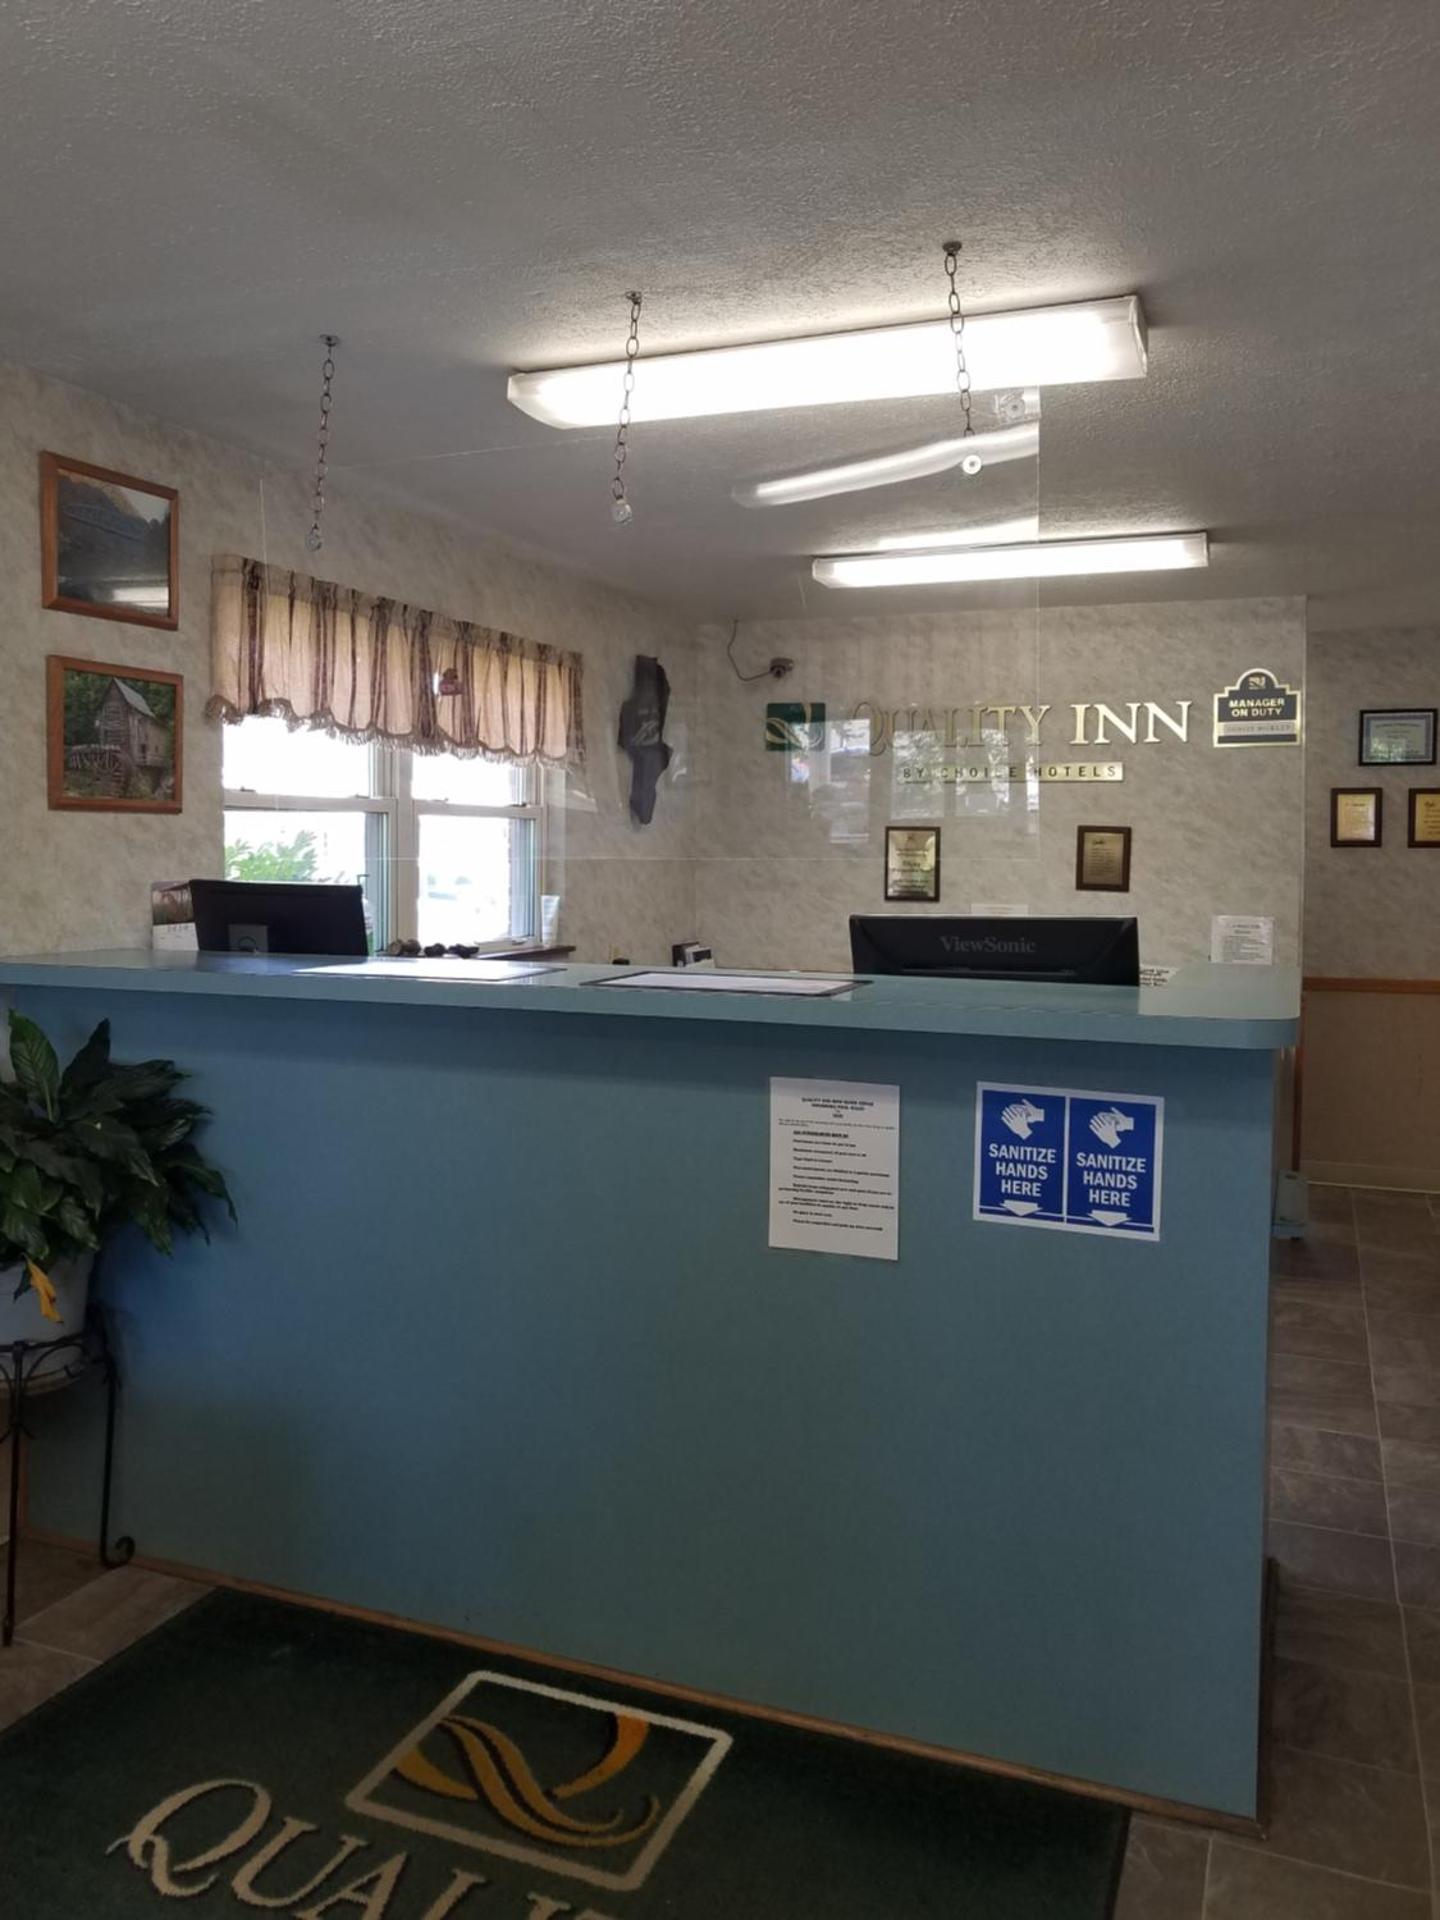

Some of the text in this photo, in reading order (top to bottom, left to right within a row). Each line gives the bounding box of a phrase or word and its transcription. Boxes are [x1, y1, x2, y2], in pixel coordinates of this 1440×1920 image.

[1229, 698, 1285, 708] MANAGER
[1231, 708, 1282, 717] ON DUTY
[1070, 700, 1192, 746] INN
[903, 767, 924, 778] BY
[1033, 766, 1118, 778] HOTELS
[939, 936, 1037, 953] ViewSonic
[988, 1142, 1057, 1165] SANITIZE
[1075, 1151, 1147, 1174] SANITIZE
[995, 1161, 1049, 1181] HANDS
[1082, 1171, 1138, 1190] HANDS
[1001, 1180, 1042, 1198] HERE
[1088, 1189, 1131, 1208] HERE
